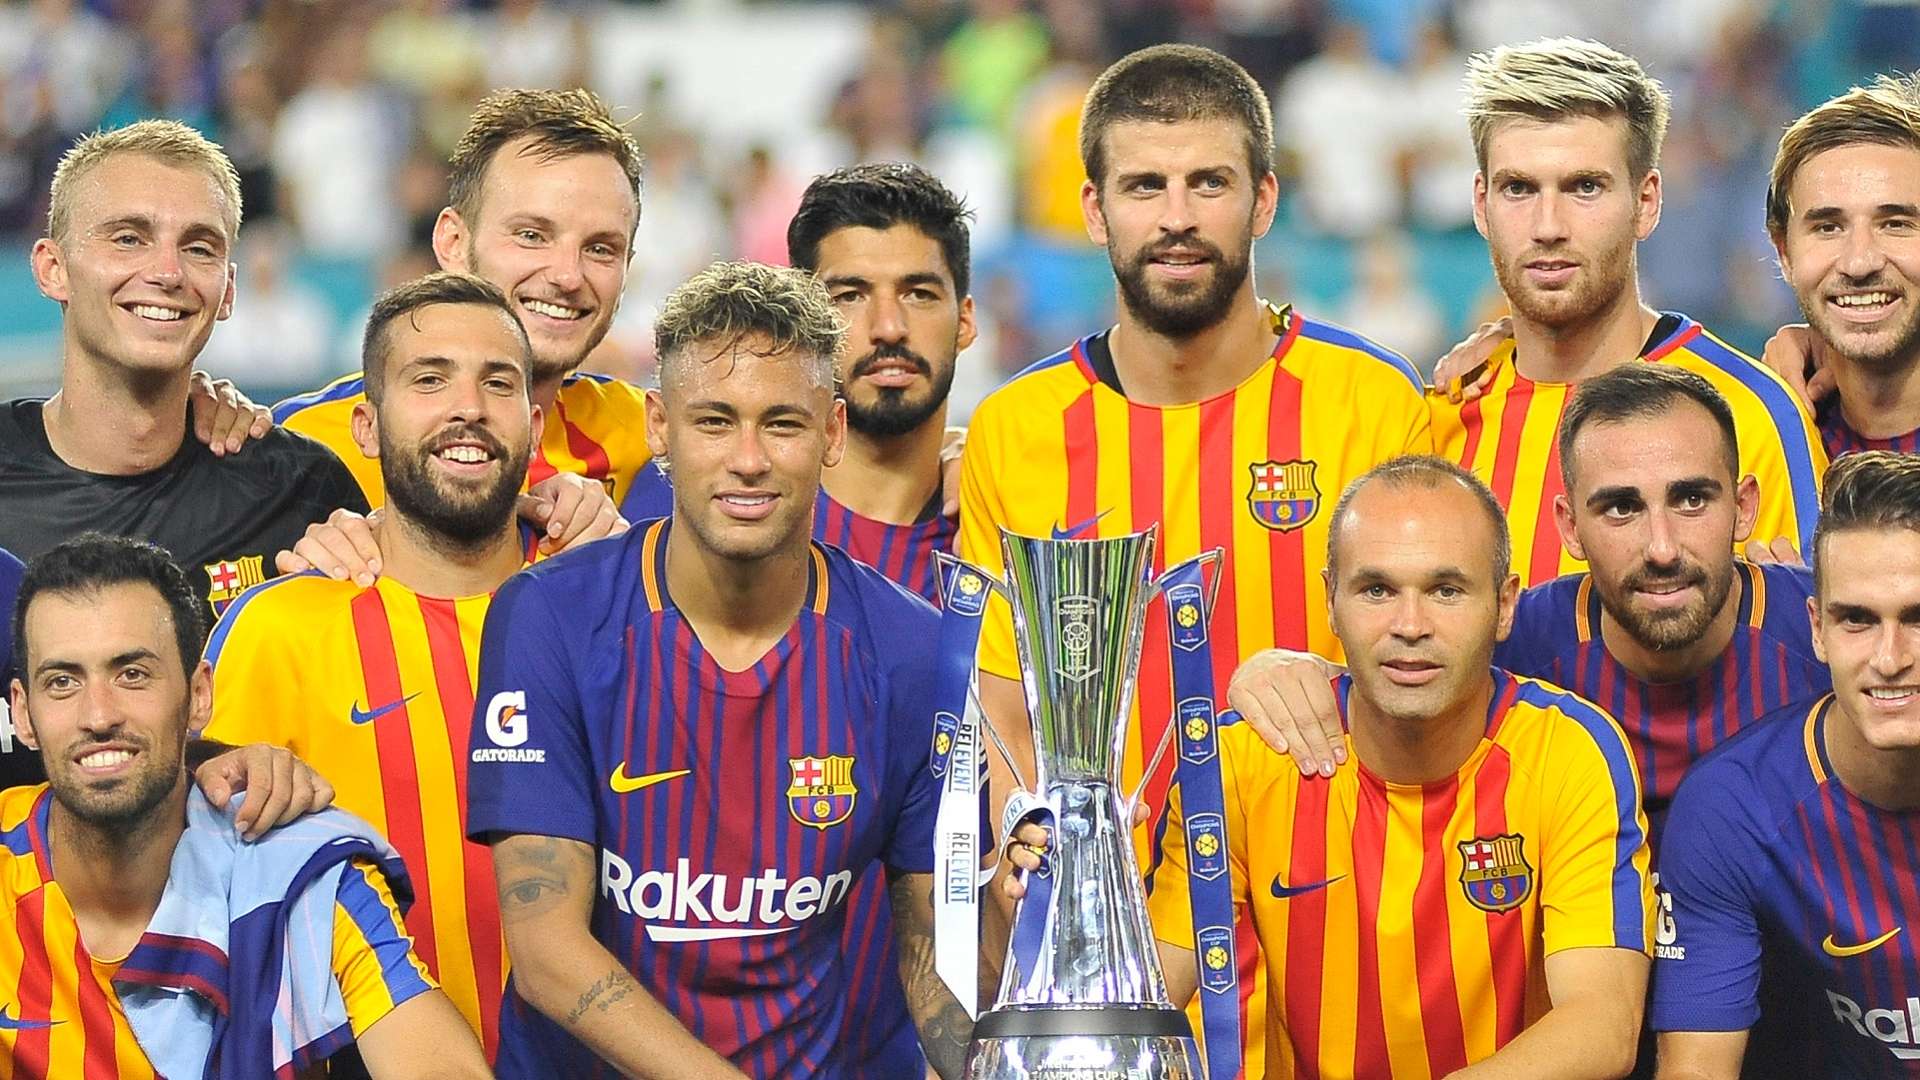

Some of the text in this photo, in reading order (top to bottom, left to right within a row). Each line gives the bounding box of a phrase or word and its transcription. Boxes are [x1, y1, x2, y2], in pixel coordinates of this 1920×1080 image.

[1270, 491, 1297, 500] FCB
[472, 748, 546, 764] GATORADE
[953, 724, 972, 794] RELEVENT
[807, 785, 835, 796] FCB
[951, 833, 970, 905] RELEVENT
[1482, 867, 1508, 879] FCB
[602, 847, 852, 924] Rakuten
